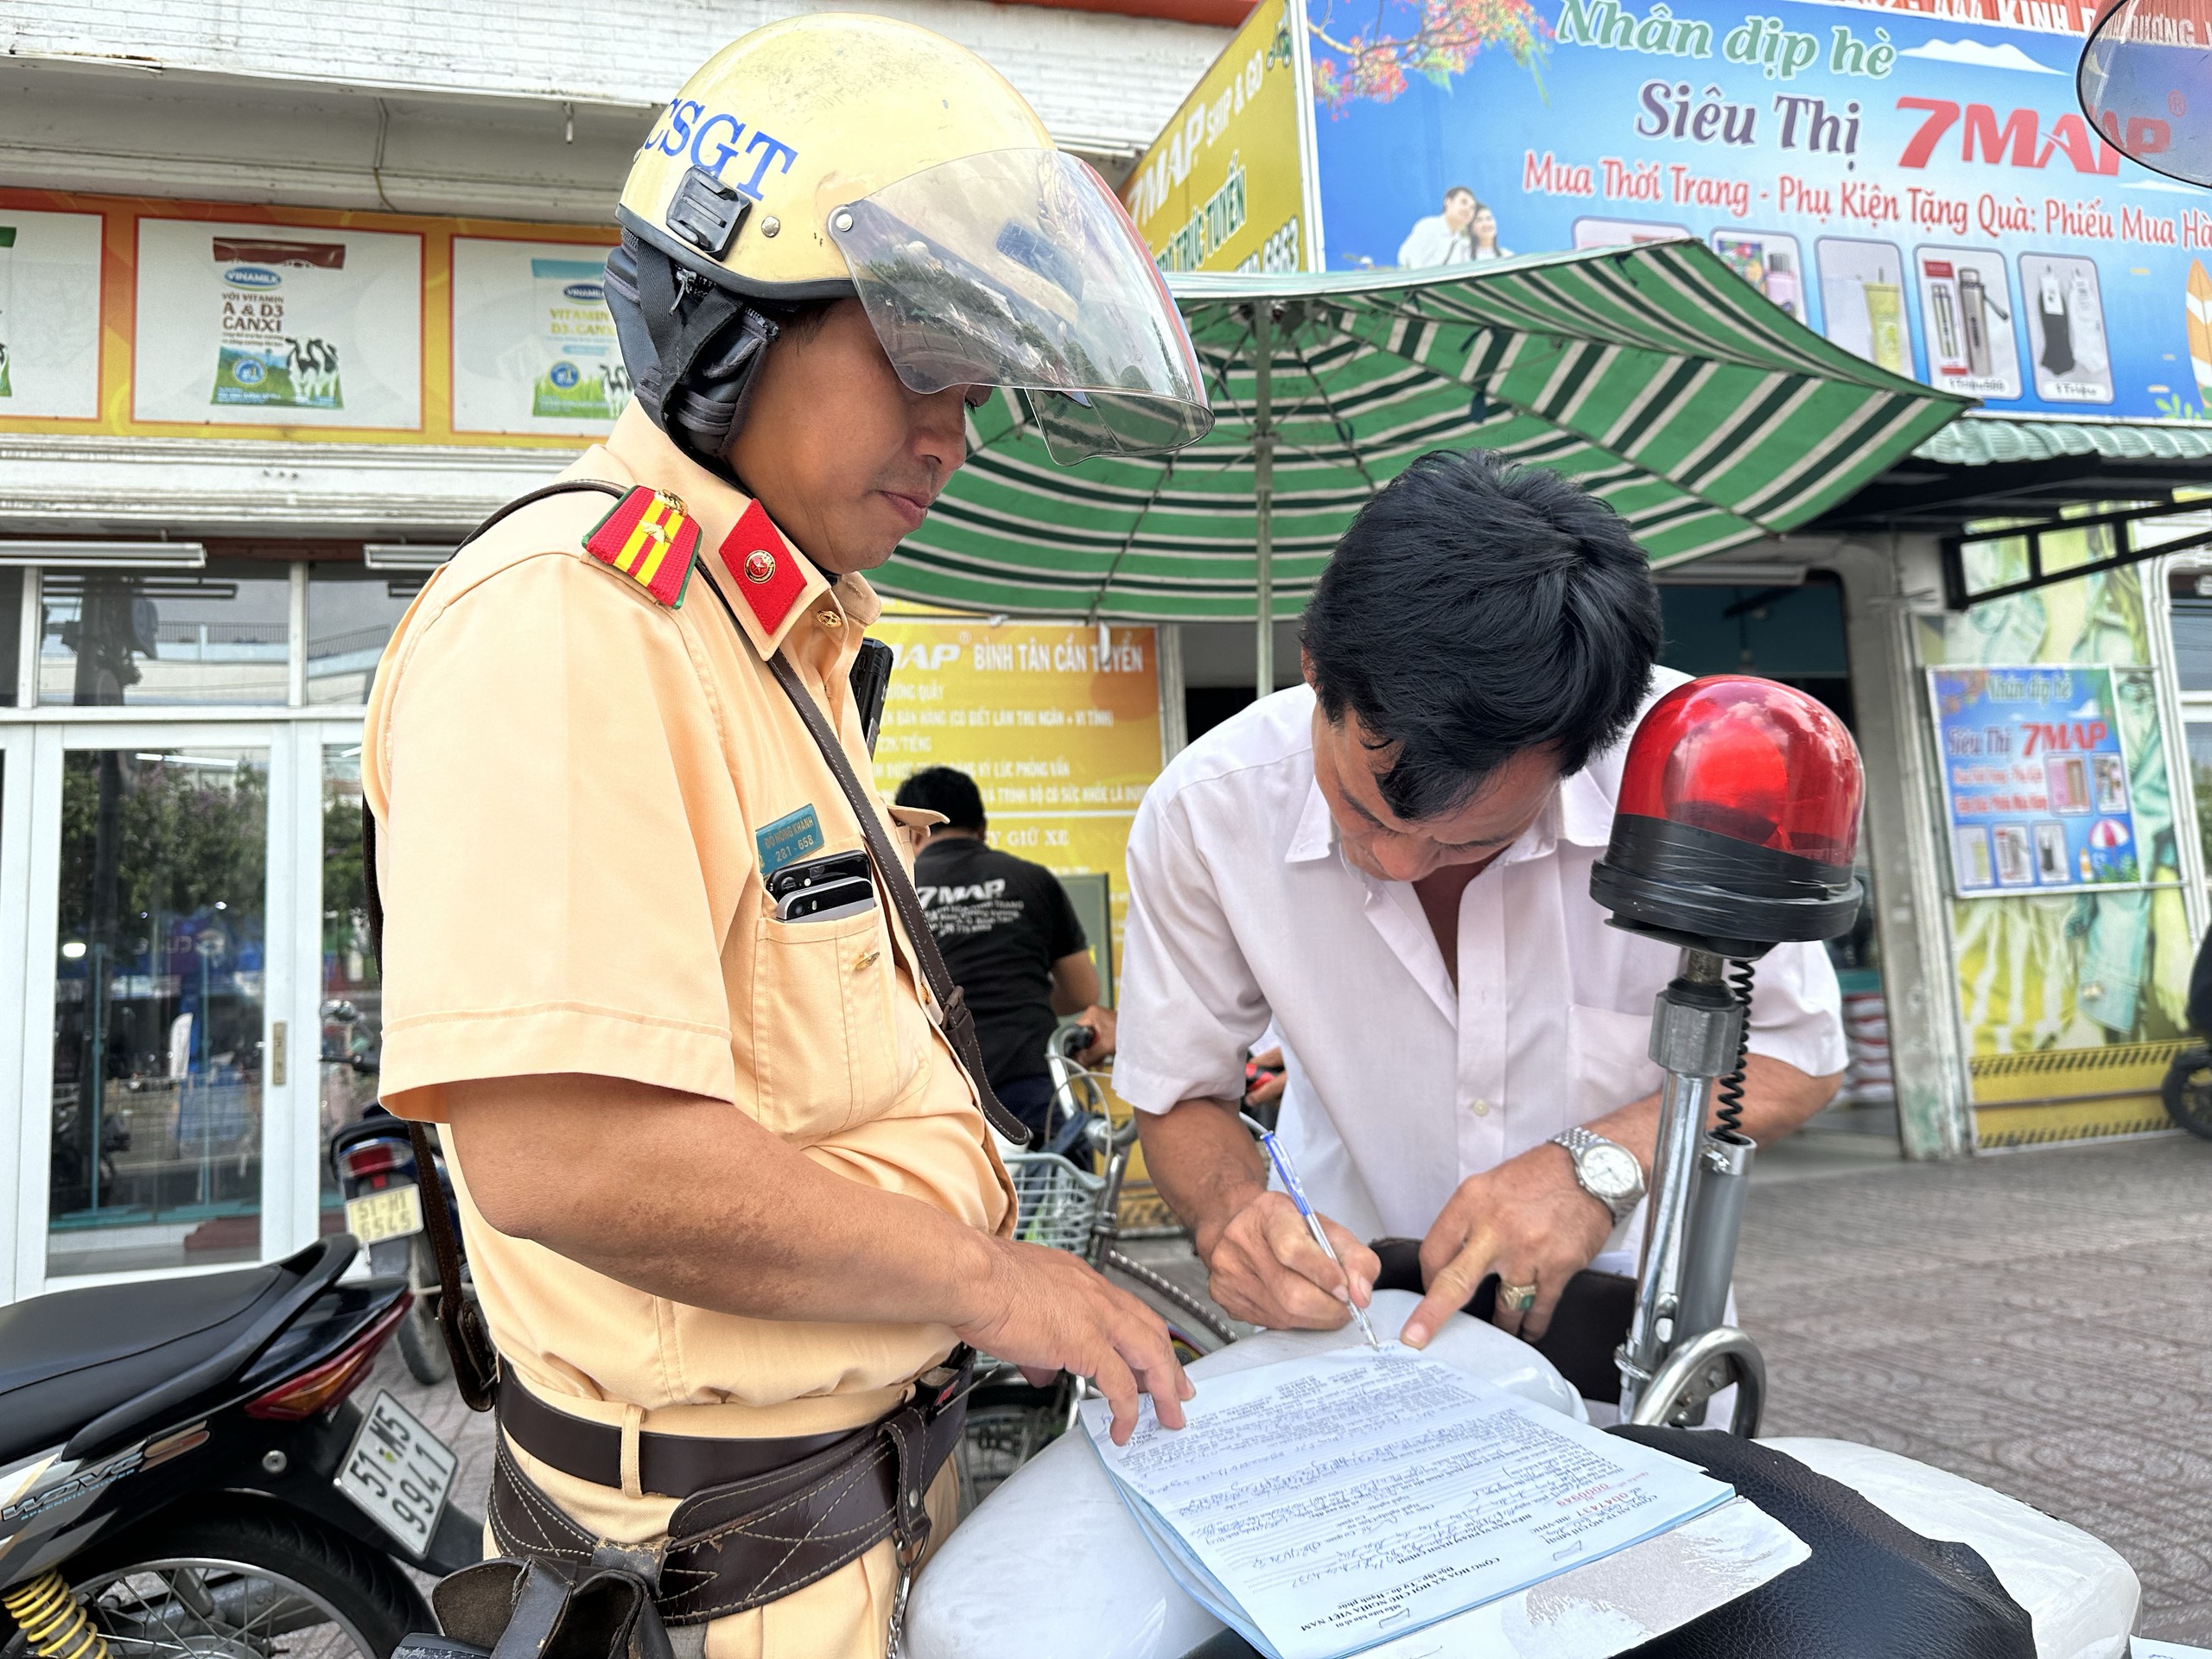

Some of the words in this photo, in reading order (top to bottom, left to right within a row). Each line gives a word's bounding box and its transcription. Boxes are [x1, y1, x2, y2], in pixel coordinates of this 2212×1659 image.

[1558, 0, 1711, 58] Nhân
[1725, 16, 1818, 79] dịp
[1830, 27, 1896, 76] hè
[1637, 81, 1756, 144] Siêu
[1775, 94, 1860, 170] Thị
[1896, 96, 2171, 176] 7MAP
[1524, 153, 1592, 195] Mua
[1601, 157, 1661, 200] Thời
[1669, 165, 1749, 216] Trang
[1778, 176, 1829, 222] Phụ
[1841, 181, 1899, 226] Kiện
[1907, 188, 1967, 234] Tặng
[1977, 194, 2037, 238] Quà:
[2045, 198, 2114, 239] Phiếu
[2121, 205, 2177, 245] Mua
[229, 271, 277, 283] VINAMILK
[567, 289, 605, 300] VINAMIL
[223, 302, 235, 315] A
[242, 304, 254, 315] &
[261, 304, 283, 317] D3
[223, 317, 282, 332] CANXI
[974, 636, 1014, 671] BÌNH
[2021, 721, 2107, 758] 7MAP
[776, 846, 791, 861] 281
[798, 835, 813, 849] 658
[916, 878, 1006, 909] 7MAP
[392, 1443, 448, 1534] 9941
[1468, 1556, 1501, 1570] CỘNG
[1324, 1608, 1352, 1622] VIỆT
[1351, 1599, 1387, 1614] NGHĨA
[1299, 1618, 1325, 1631] NAM
